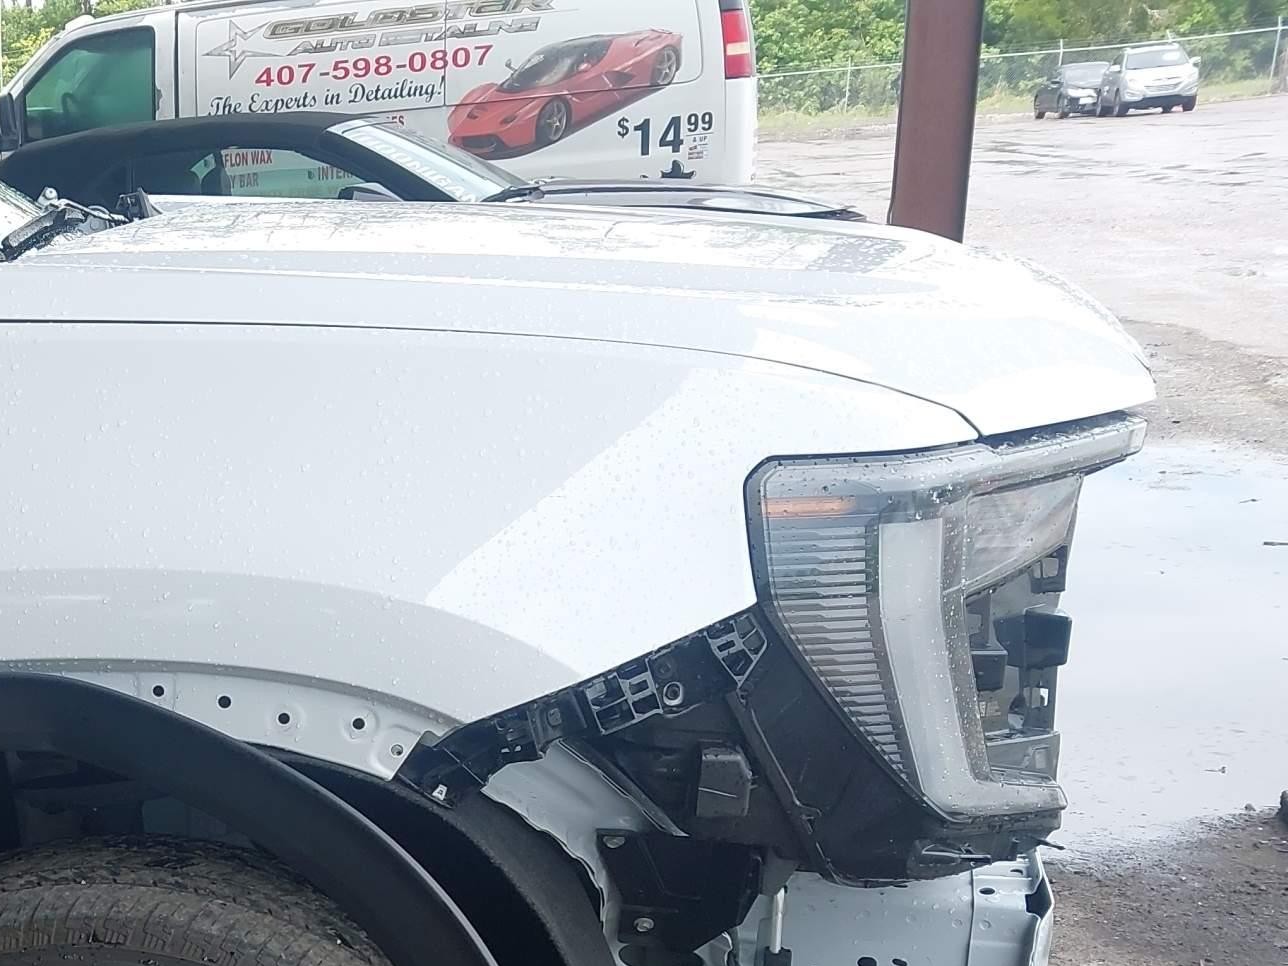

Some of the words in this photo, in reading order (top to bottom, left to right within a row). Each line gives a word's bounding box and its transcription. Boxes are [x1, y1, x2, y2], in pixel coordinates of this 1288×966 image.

[286, 33, 376, 56] AUTO
[379, 17, 541, 47] DETAILING
[254, 45, 494, 87] 407-598-0807
[208, 97, 242, 116] The
[248, 92, 317, 114] Experts
[324, 88, 341, 105] in
[348, 77, 445, 103] Detailing!
[251, 150, 273, 165] WAX
[239, 172, 259, 188] BAR
